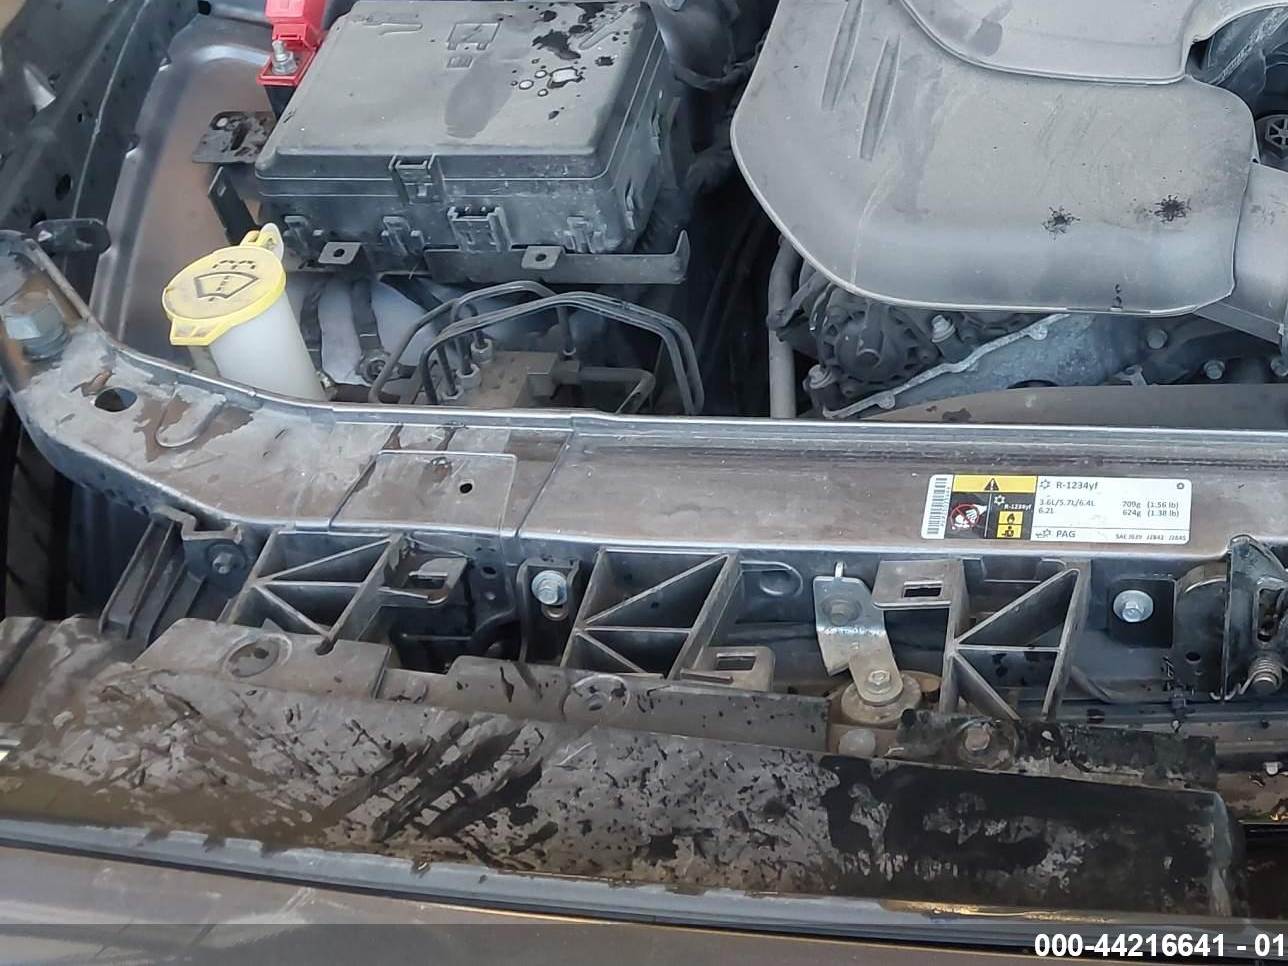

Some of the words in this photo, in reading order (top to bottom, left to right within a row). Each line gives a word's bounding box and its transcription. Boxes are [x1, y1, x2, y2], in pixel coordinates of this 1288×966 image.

[1056, 481, 1099, 490] R-1234yf
[1122, 500, 1141, 508] 709g
[1056, 530, 1076, 538] PAG
